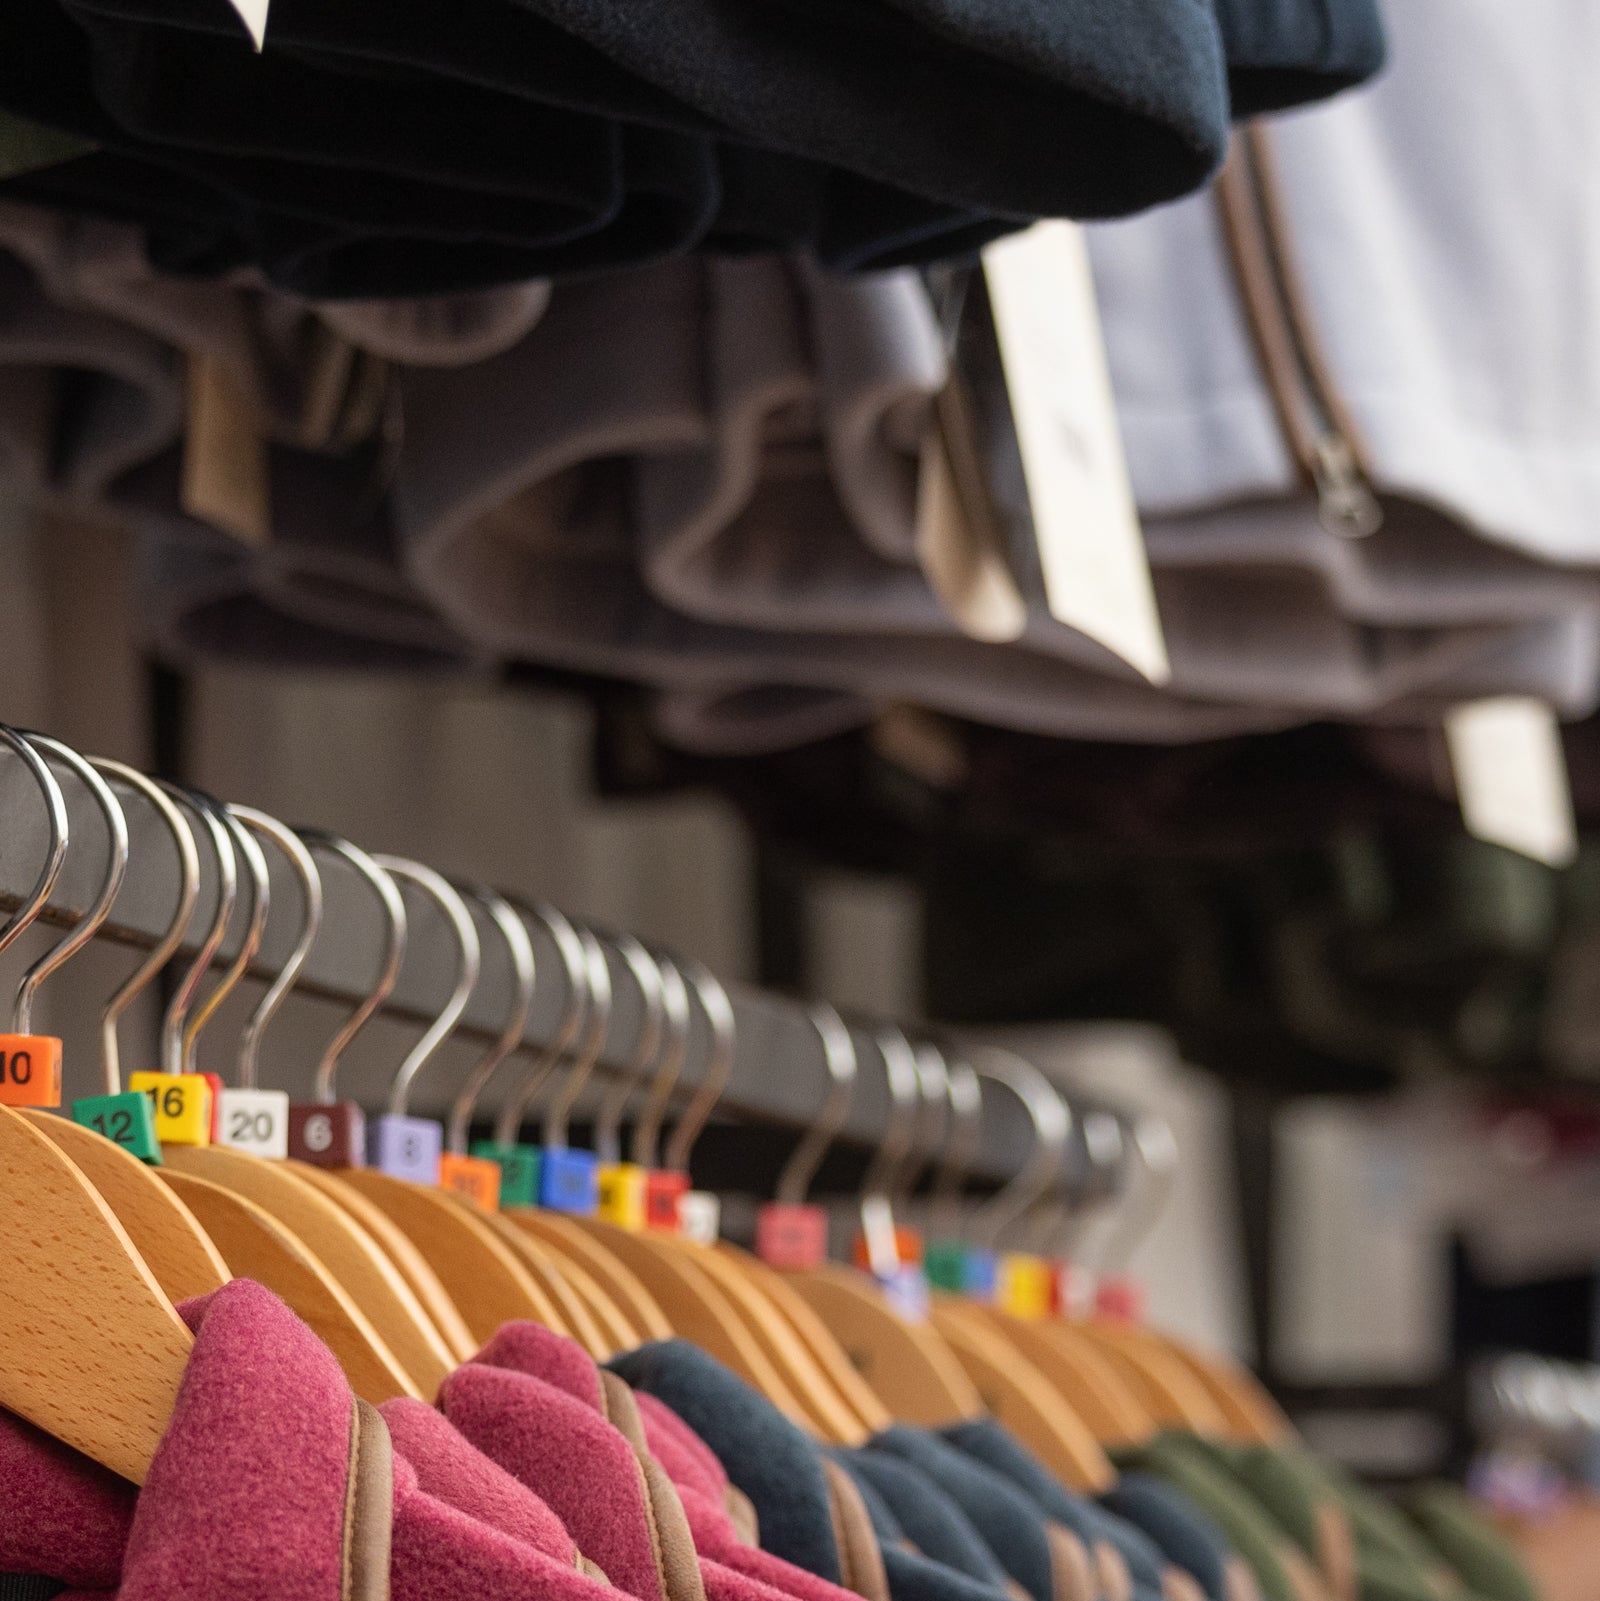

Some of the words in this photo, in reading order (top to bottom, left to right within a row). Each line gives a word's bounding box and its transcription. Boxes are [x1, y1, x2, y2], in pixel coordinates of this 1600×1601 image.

[146, 1087, 184, 1118] 16
[92, 1111, 135, 1143] 12
[231, 1110, 273, 1142] 20
[303, 1113, 334, 1152] 6
